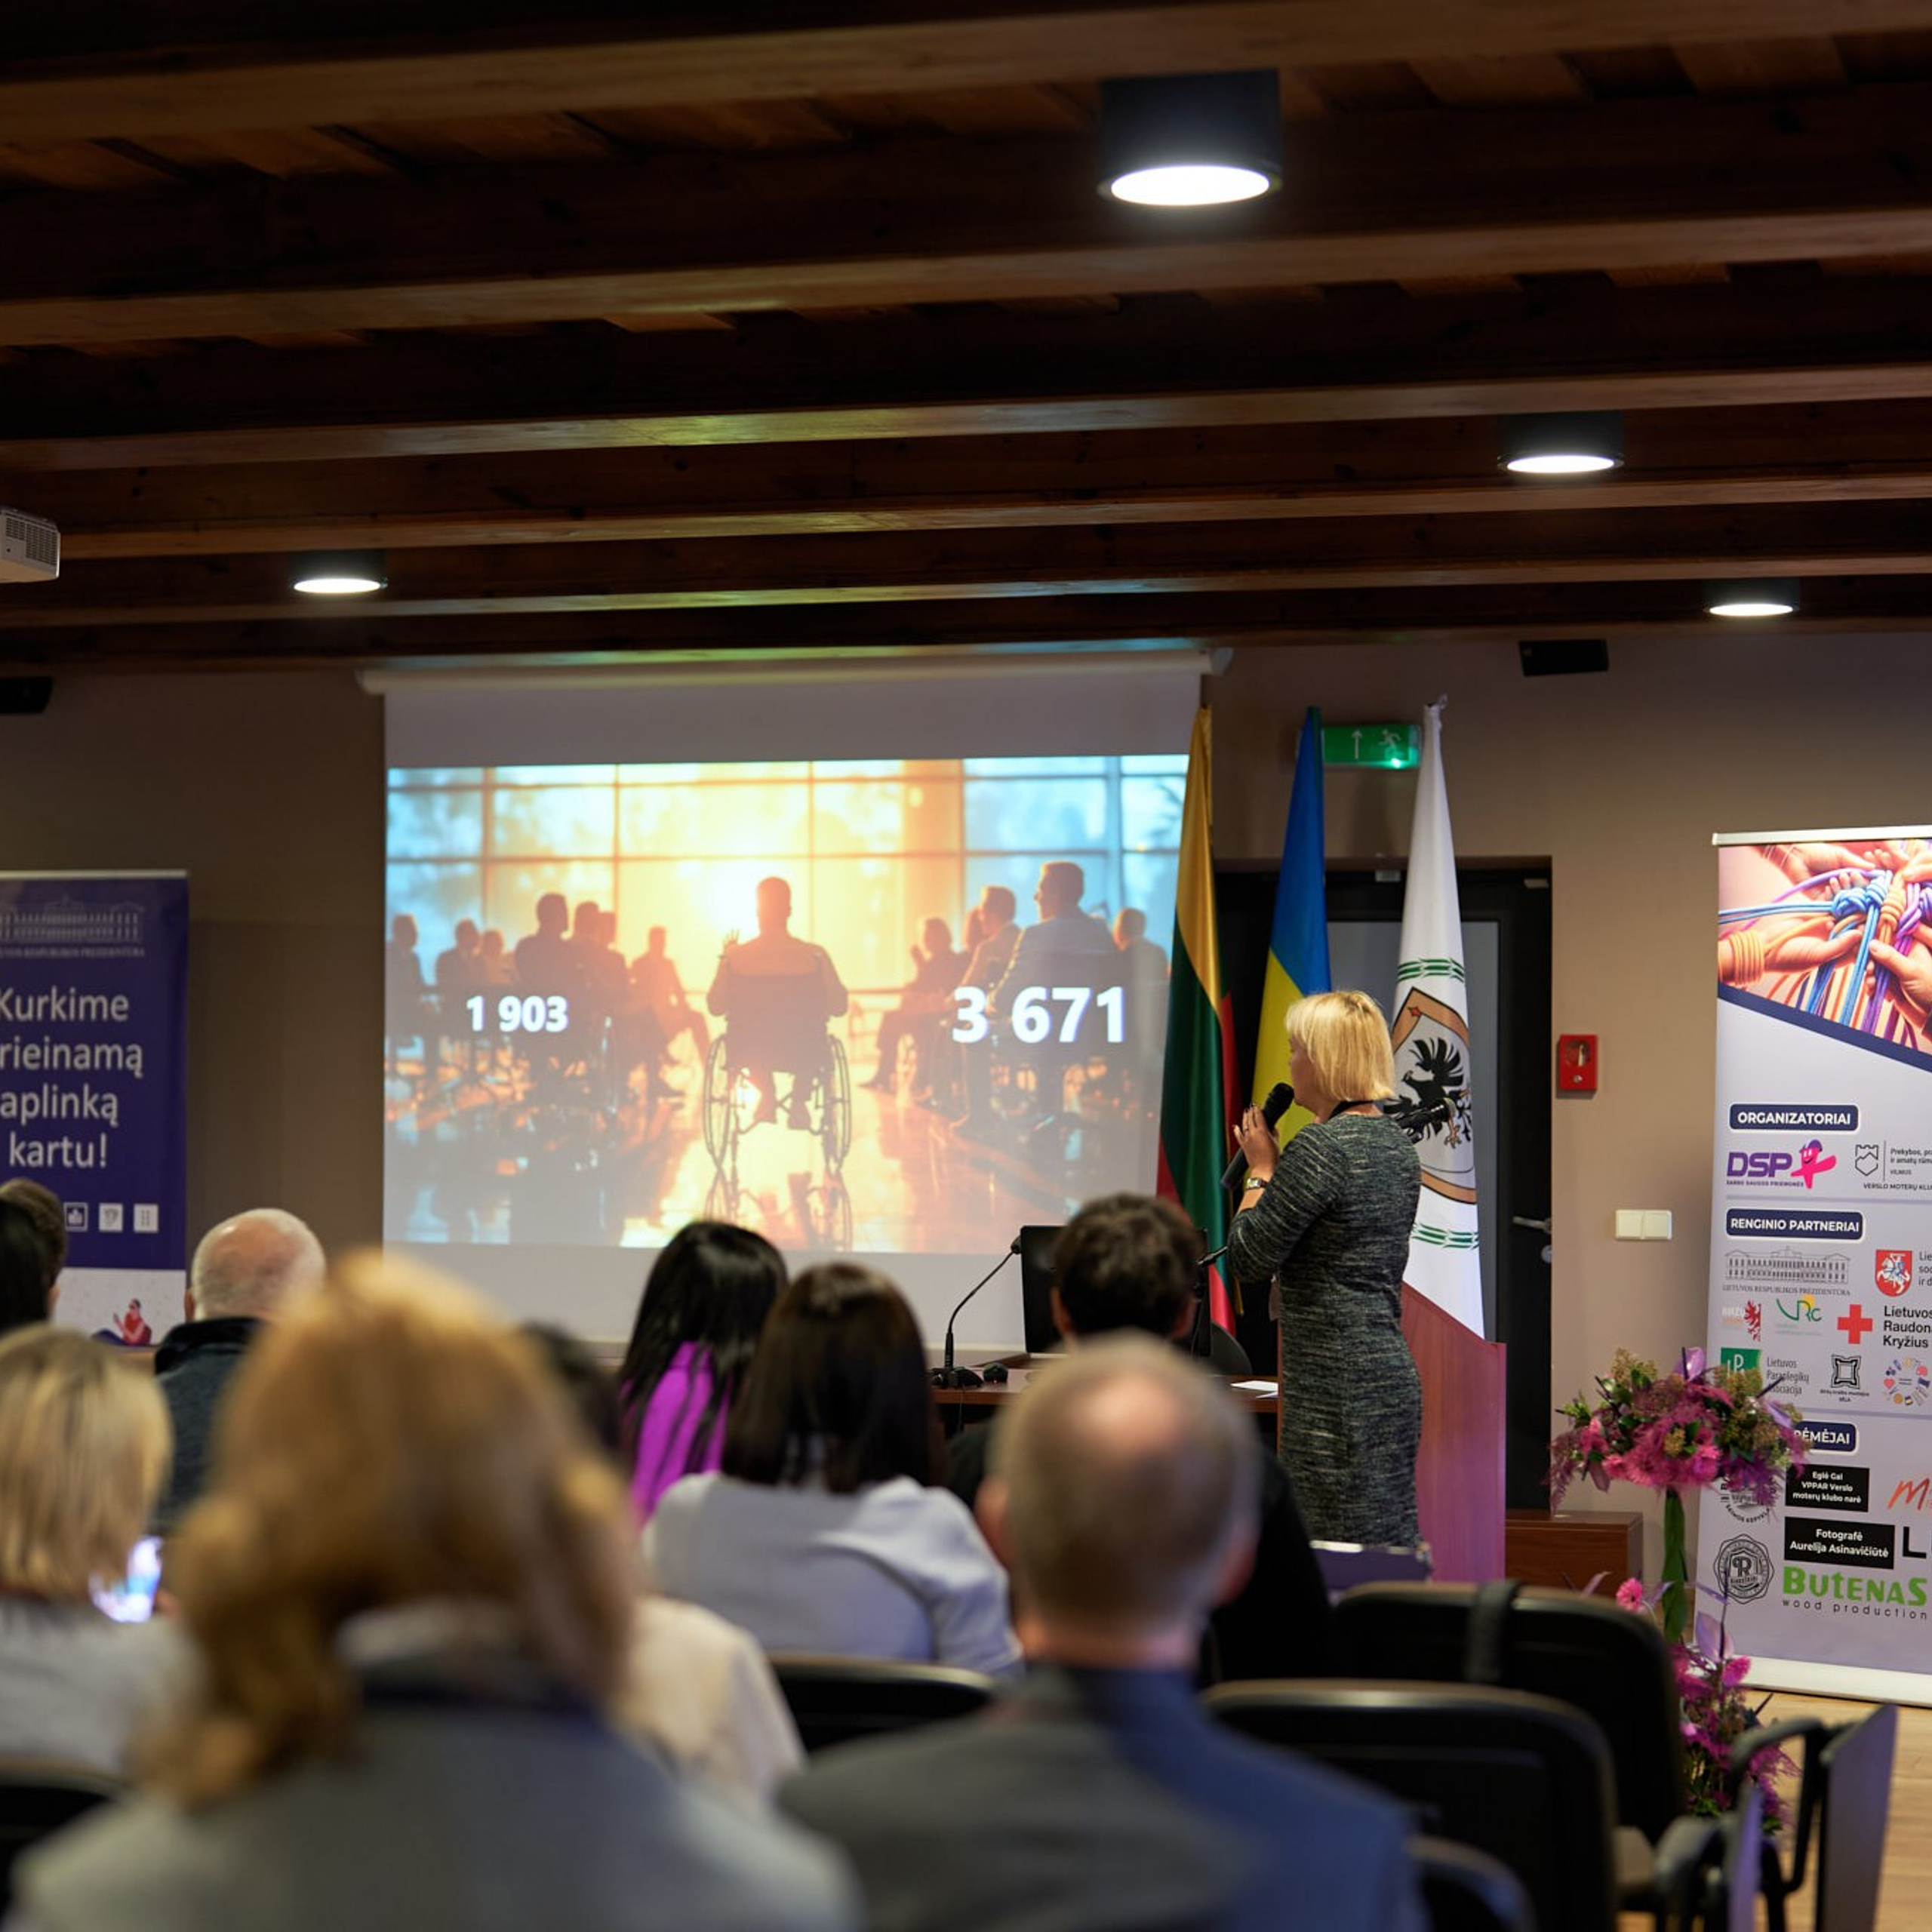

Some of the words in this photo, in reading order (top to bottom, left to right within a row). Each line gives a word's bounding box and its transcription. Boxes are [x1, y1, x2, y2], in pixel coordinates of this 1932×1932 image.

[0, 986, 129, 1021] Kurkime
[466, 995, 484, 1032] 1
[498, 995, 569, 1032] 903
[952, 986, 988, 1043] 3
[1011, 986, 1124, 1043] 671
[0, 1083, 118, 1127] aplinką
[1737, 1112, 1850, 1125] ORGANIZATORIAI
[9, 1131, 107, 1168] kartu!
[1727, 1152, 1792, 1177] DSP
[1730, 1218, 1786, 1230] RENGINIO
[1789, 1219, 1860, 1232] PARTNERIAI
[1883, 1319, 1932, 1333] Raudon
[1883, 1334, 1929, 1349] Kryžius
[1767, 1357, 1797, 1368] Lietuvos
[1812, 1471, 1829, 1481] Eglė
[1801, 1481, 1828, 1490] VPPAR
[1829, 1484, 1853, 1492] Verslo
[1792, 1493, 1820, 1502] moterų
[1822, 1494, 1843, 1502] klubo
[1816, 1529, 1863, 1541] Fotografė
[1790, 1541, 1826, 1553] Aurelija
[1783, 1600, 1822, 1610] wood
[1833, 1603, 1927, 1620] production
